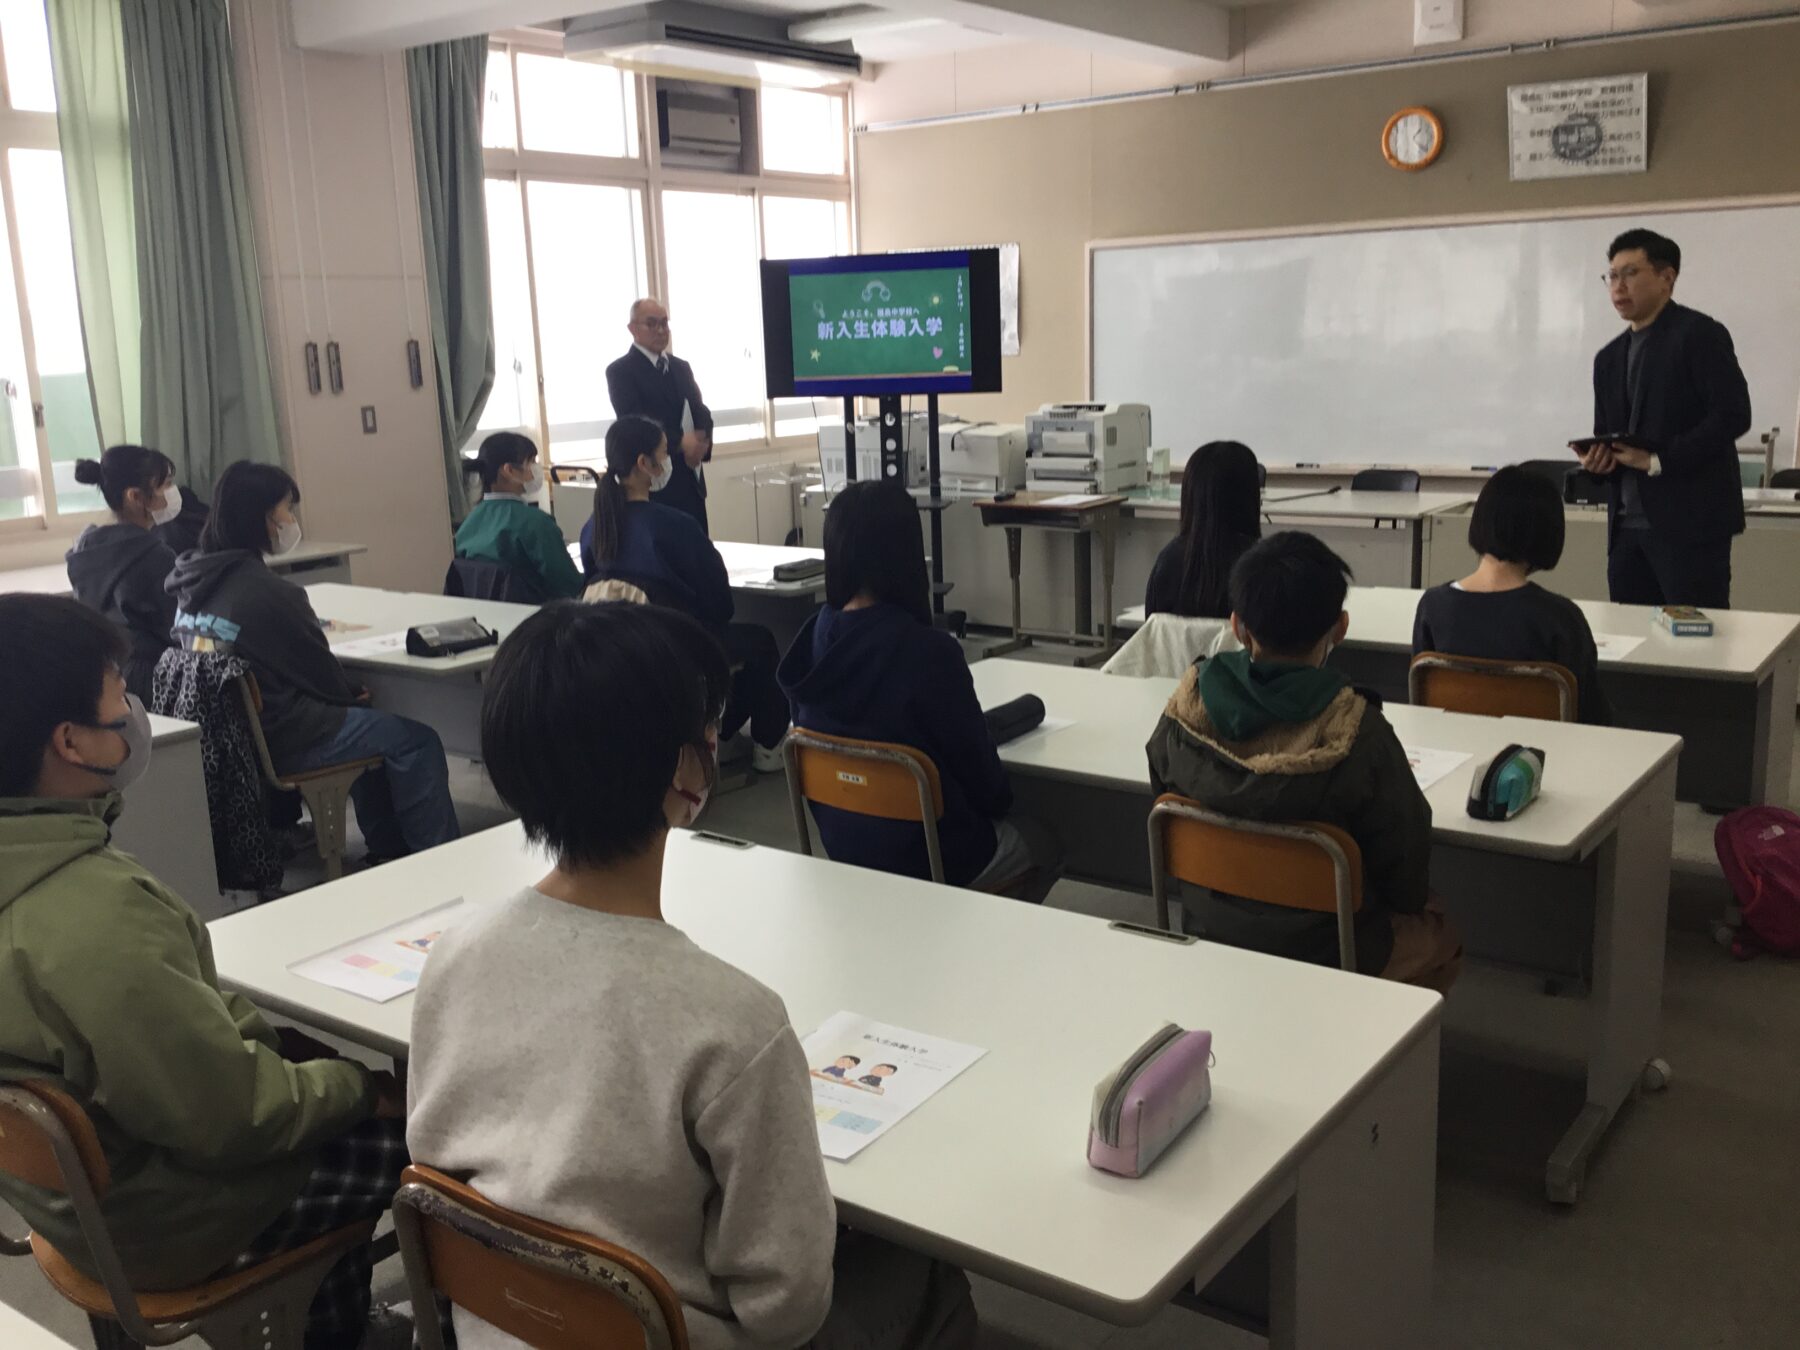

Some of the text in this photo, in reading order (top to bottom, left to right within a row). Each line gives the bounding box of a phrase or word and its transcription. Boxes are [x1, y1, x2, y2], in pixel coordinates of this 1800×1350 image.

[817, 318, 943, 341] 新入生体験入学
